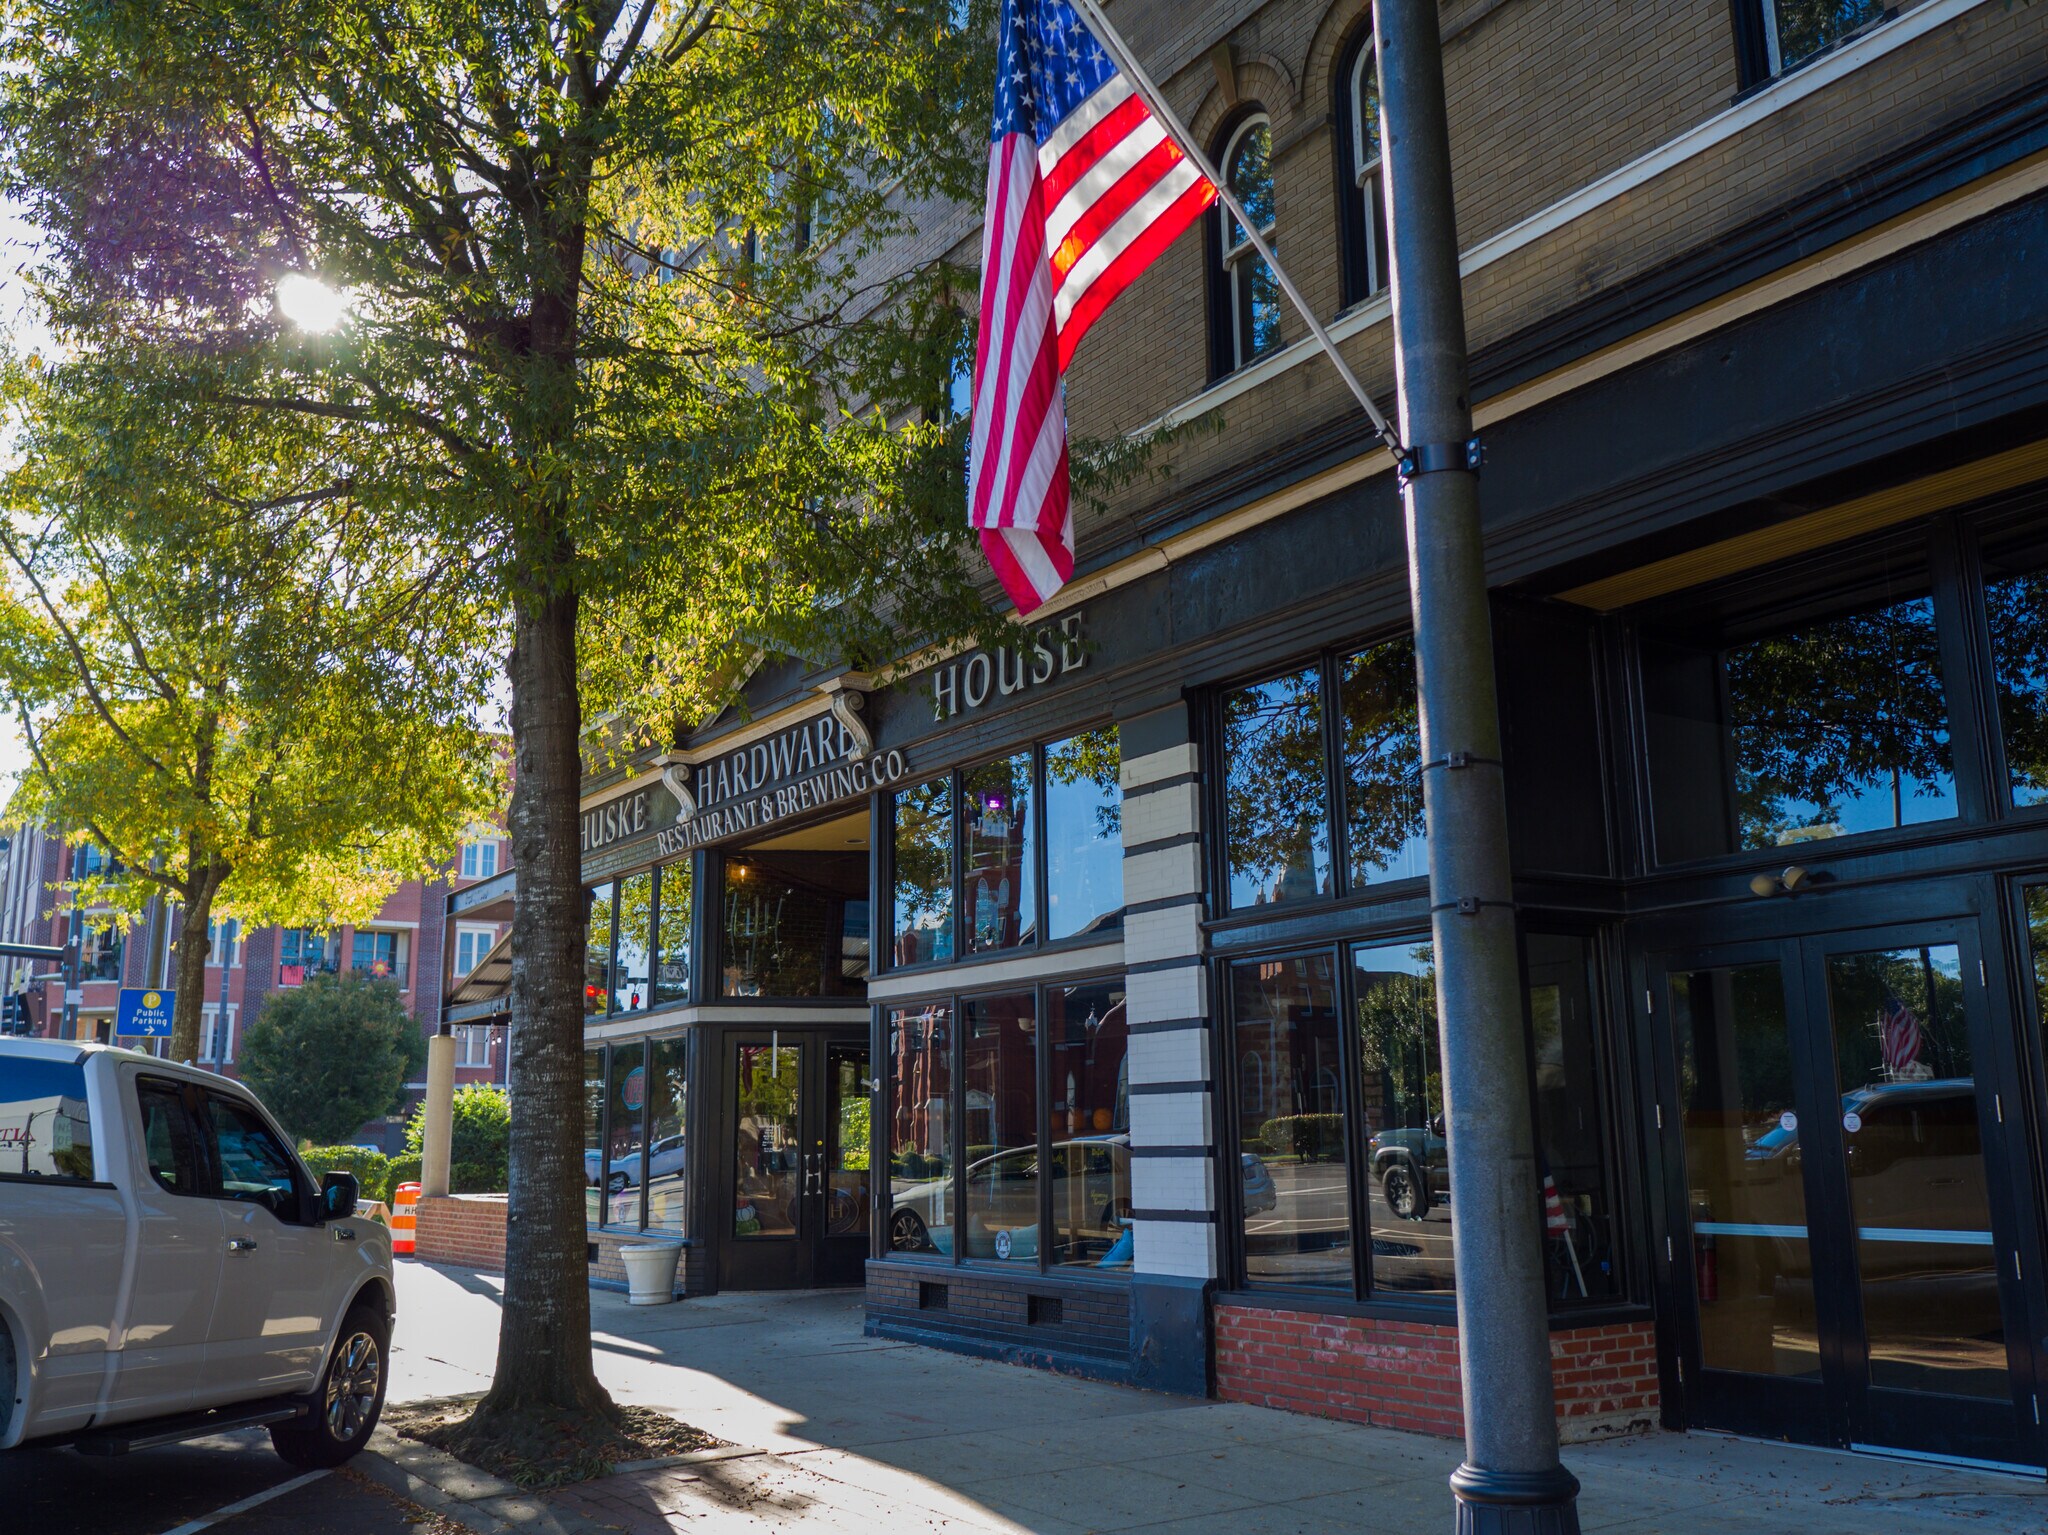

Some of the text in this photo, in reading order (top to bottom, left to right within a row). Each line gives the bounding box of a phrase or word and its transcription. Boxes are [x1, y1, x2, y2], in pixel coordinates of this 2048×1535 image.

[697, 716, 855, 809] HARDWARE
[933, 610, 1084, 722] HOUSE
[656, 750, 910, 856] RESTAURANT & BREWING CO.
[132, 1016, 168, 1027] Parking
[136, 1008, 165, 1017] Public
[624, 1075, 645, 1103] OPE
